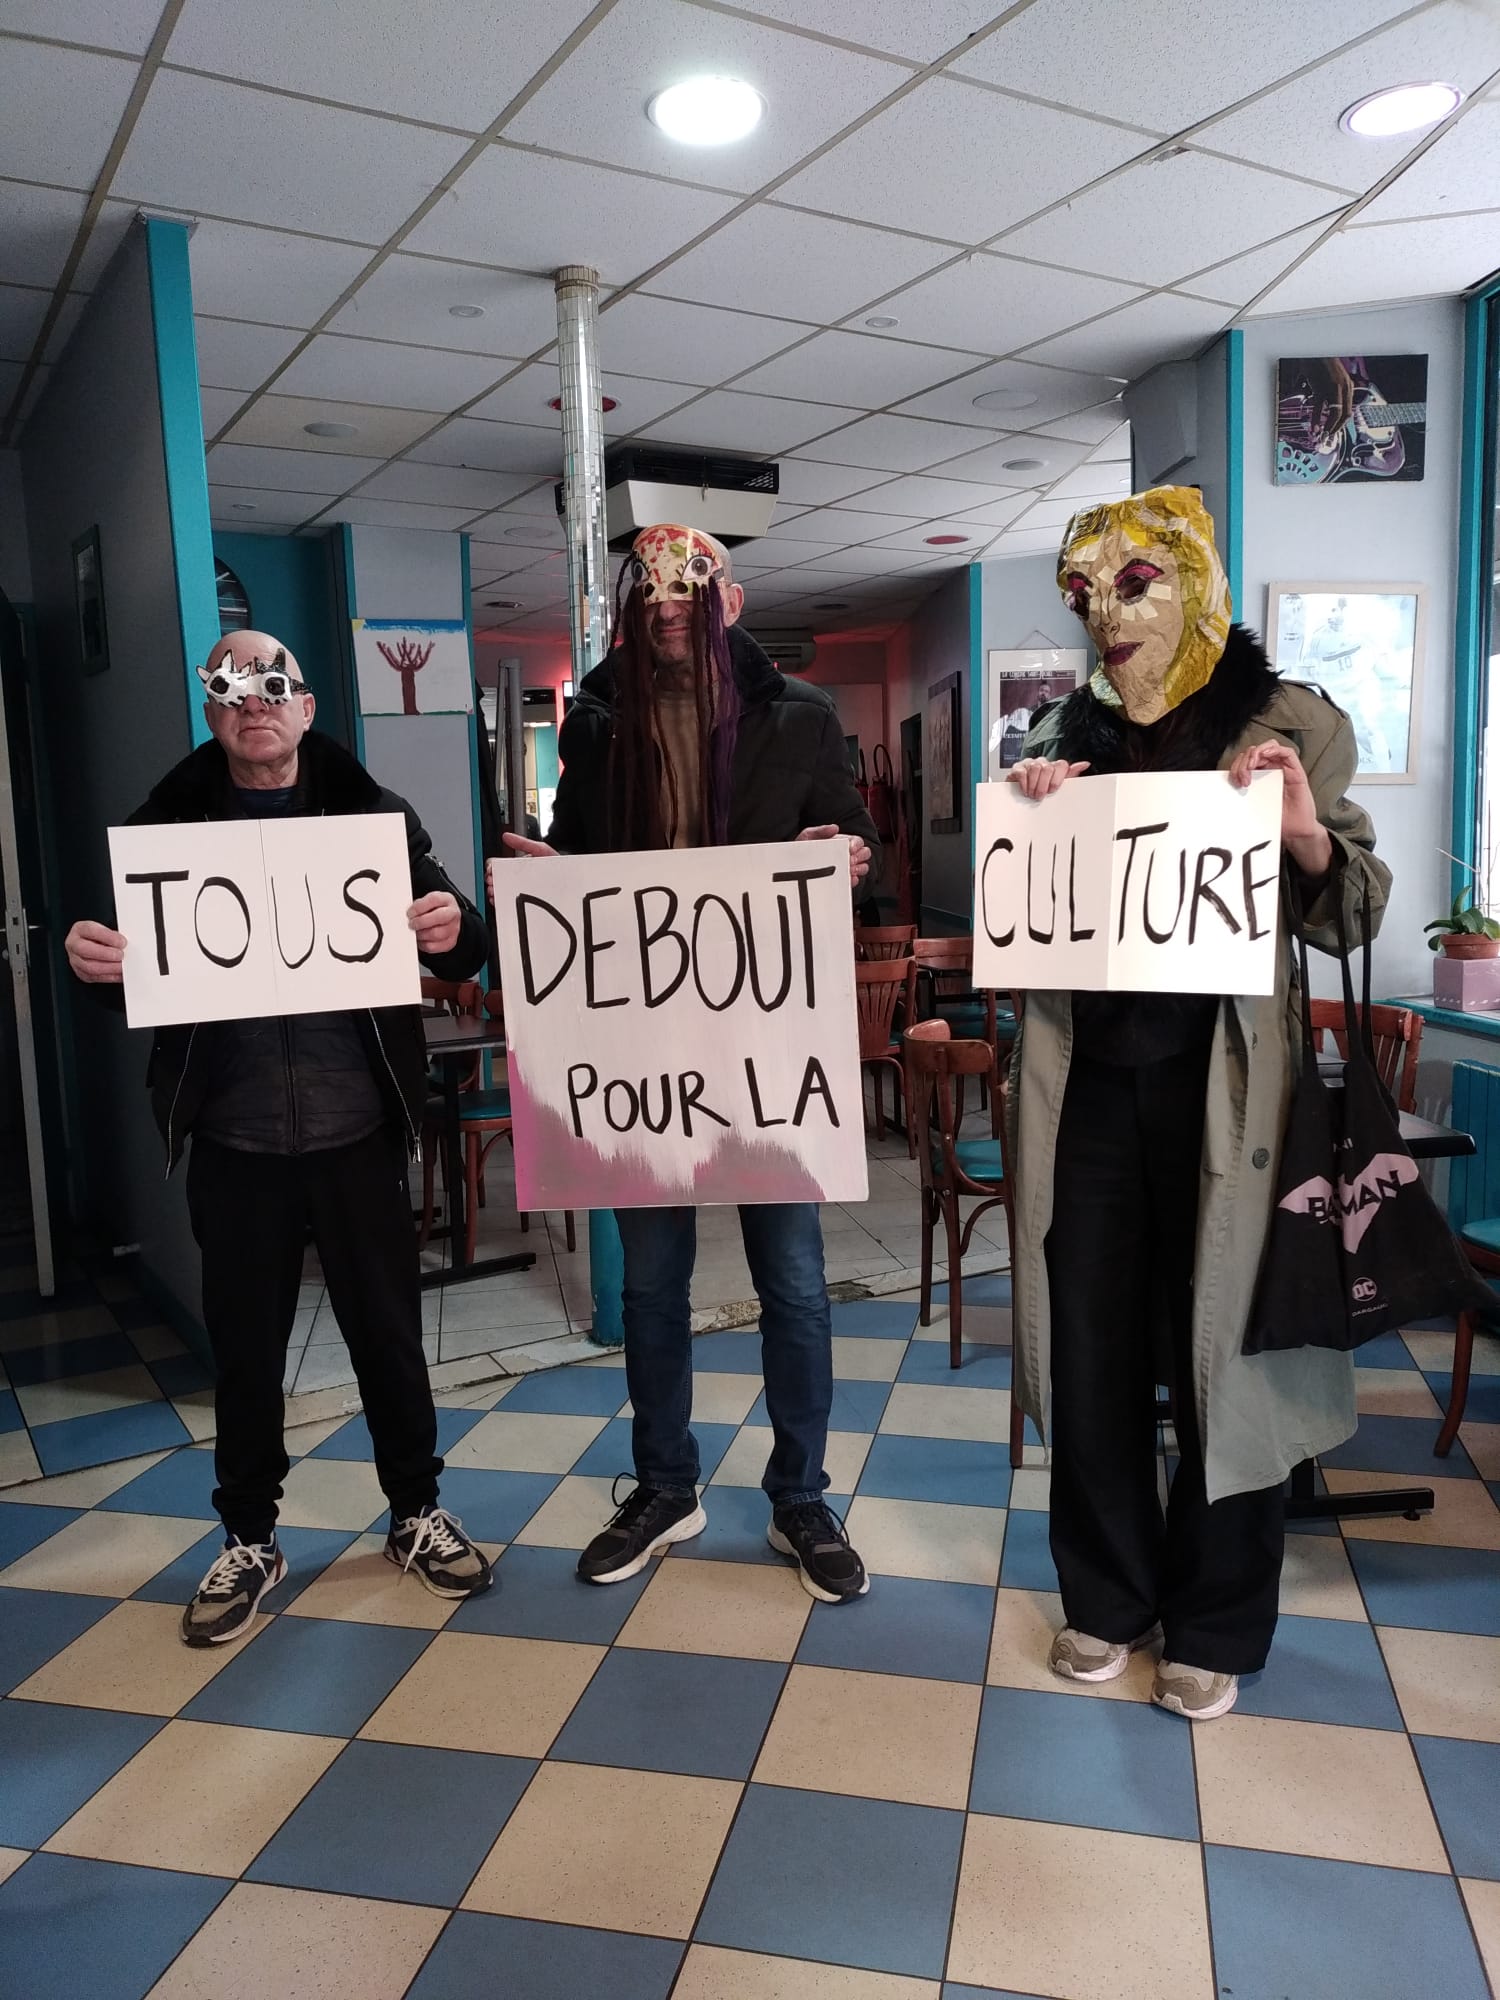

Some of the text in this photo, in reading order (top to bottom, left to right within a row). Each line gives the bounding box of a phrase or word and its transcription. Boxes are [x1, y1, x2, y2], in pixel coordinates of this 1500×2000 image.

[125, 869, 385, 976] TOUS
[981, 821, 1278, 947] CULTURE
[515, 866, 836, 1012] DEBOUT
[567, 1056, 840, 1138] POUR LA
[1352, 1280, 1376, 1299] DC
